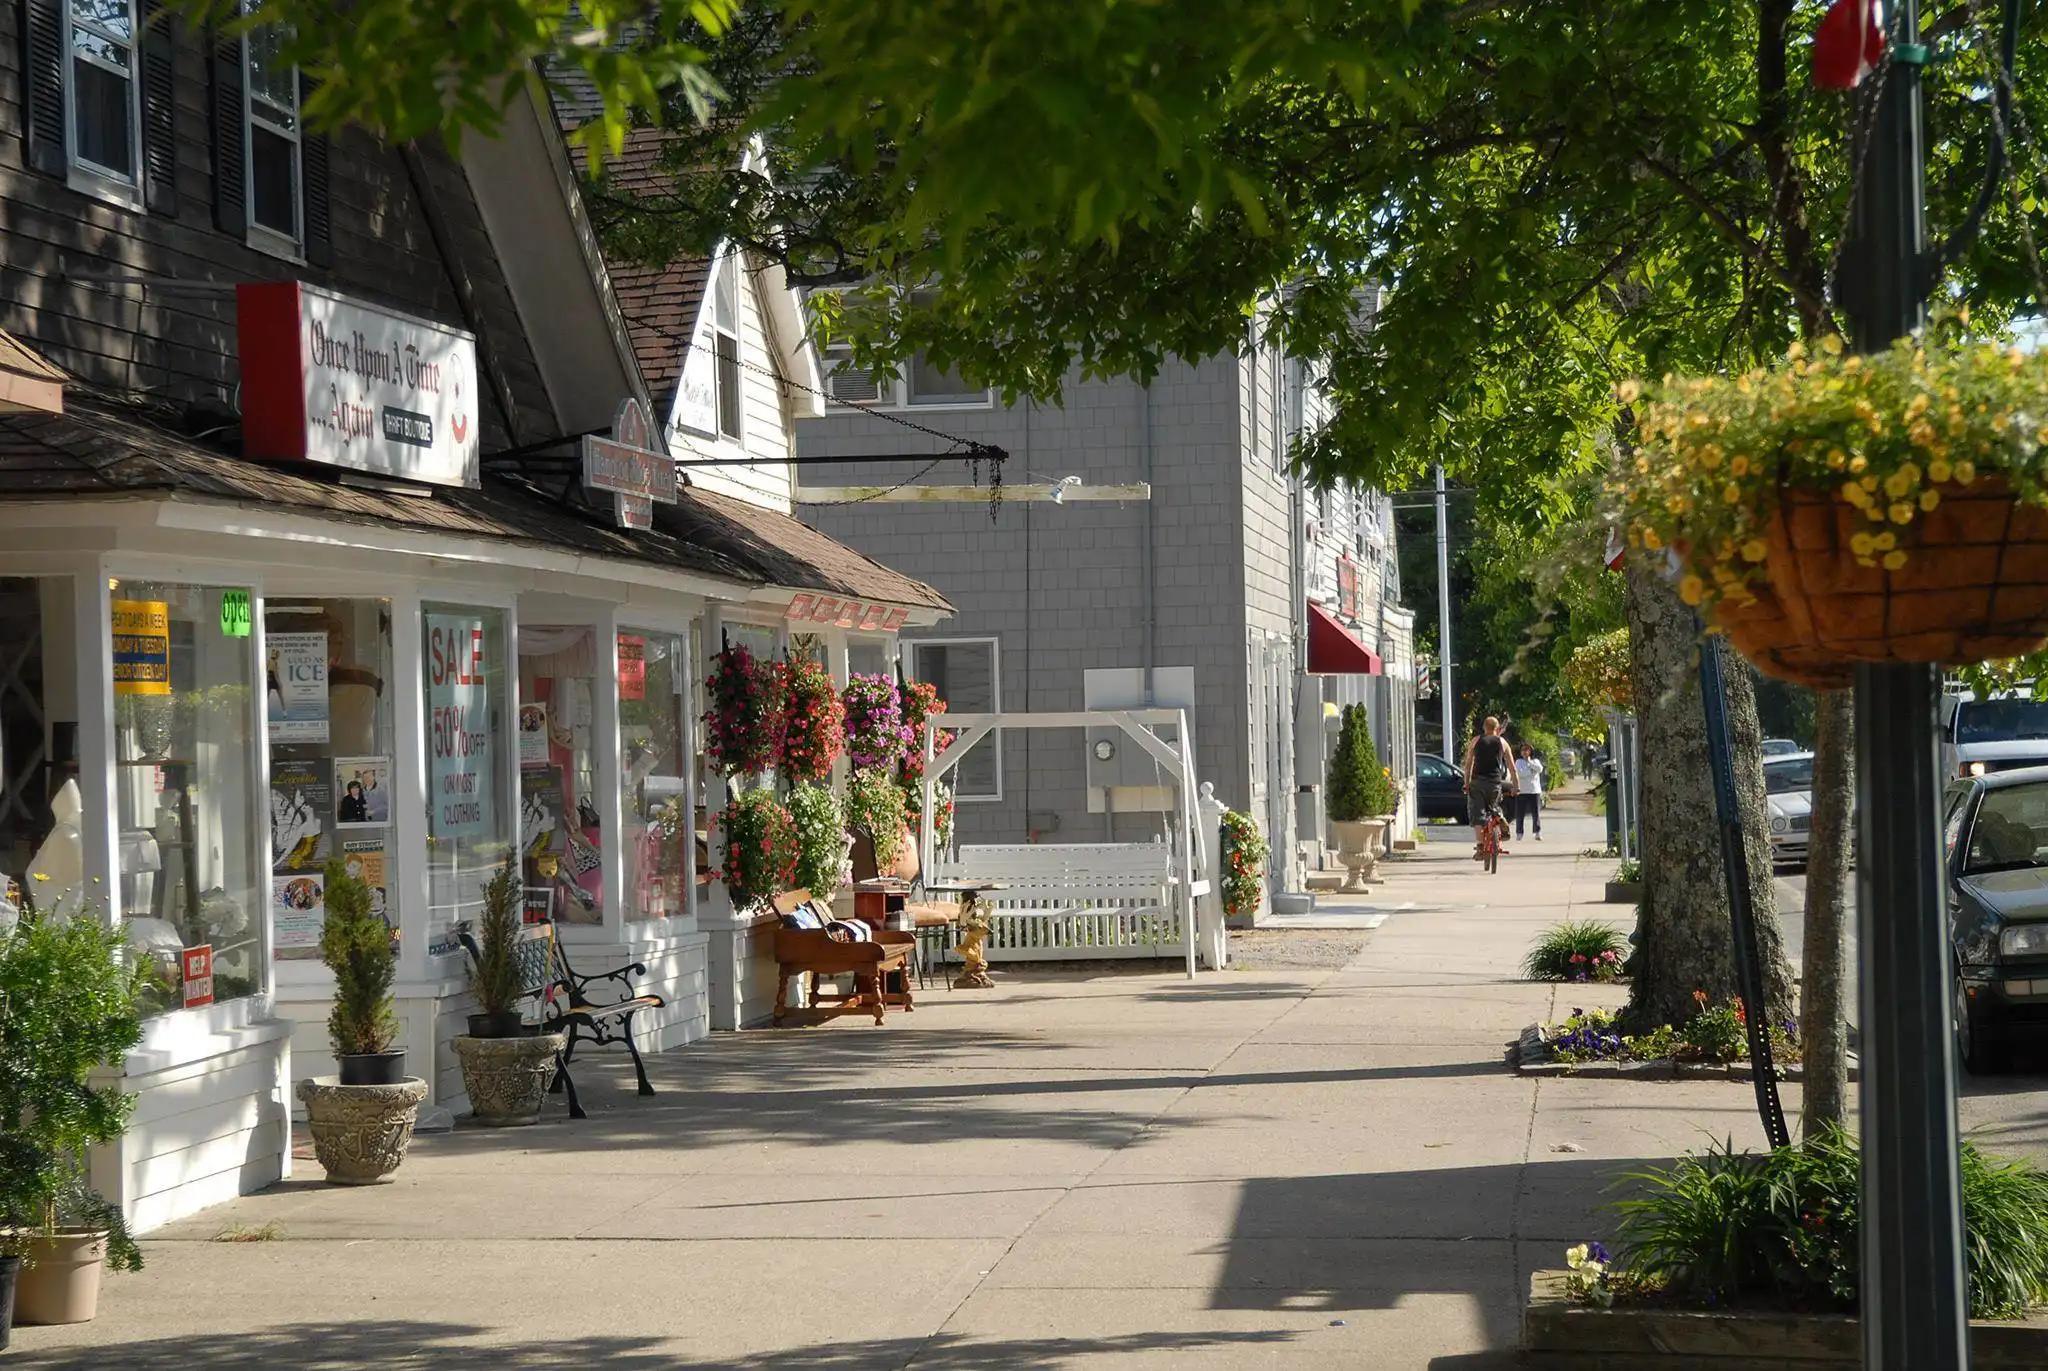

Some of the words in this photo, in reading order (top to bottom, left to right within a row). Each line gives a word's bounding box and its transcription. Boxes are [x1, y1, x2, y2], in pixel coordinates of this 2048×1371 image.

[310, 319, 350, 373] Once
[352, 329, 390, 392] Upon
[391, 341, 404, 386] A
[403, 344, 440, 394] Time
[384, 413, 403, 436] THRIFT
[404, 418, 431, 442] BOUTIQUE
[139, 638, 166, 654] TUESDAY
[431, 627, 485, 686] SALE
[288, 665, 325, 682] ICE
[433, 705, 469, 759] 50%
[469, 734, 486, 756] OFF
[444, 774, 455, 795] ON
[455, 773, 477, 794] MOST
[444, 802, 480, 825] CLOTHING
[189, 954, 205, 977] HELP
